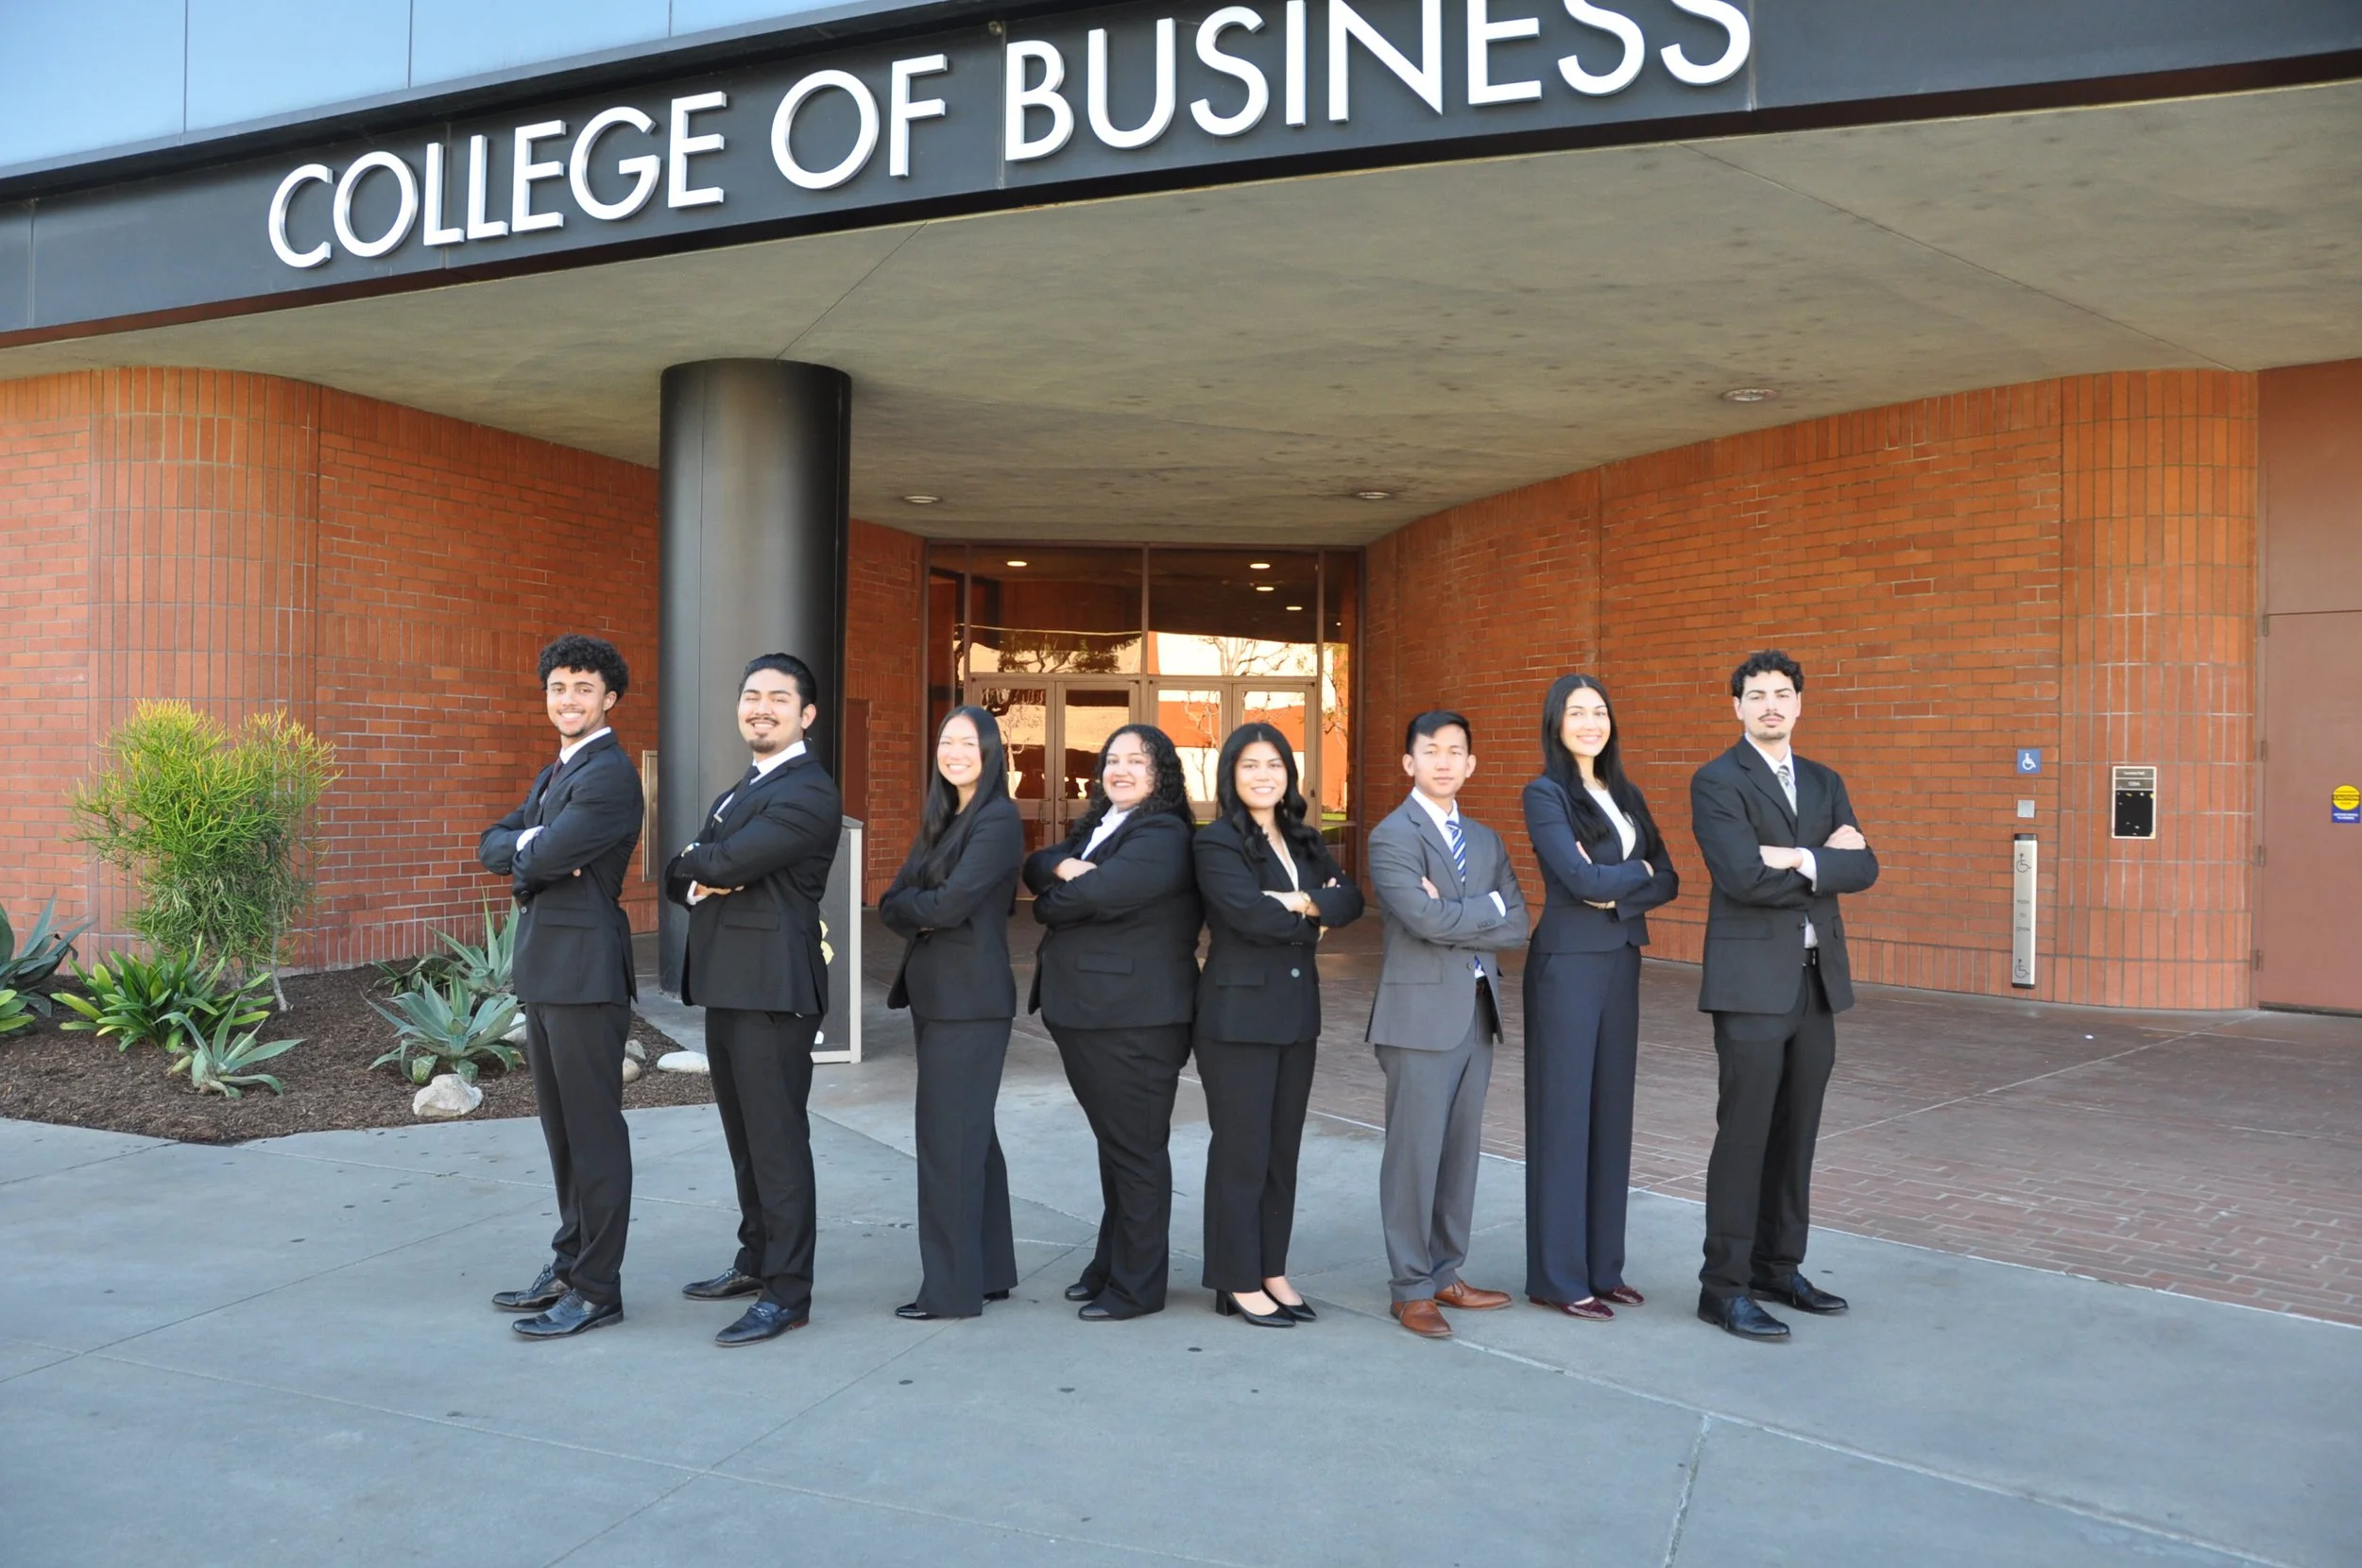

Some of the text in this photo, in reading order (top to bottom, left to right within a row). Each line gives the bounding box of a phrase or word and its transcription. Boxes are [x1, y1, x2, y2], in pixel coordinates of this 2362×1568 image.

[268, 0, 1752, 269] COLLEGE OF BUSINESS
